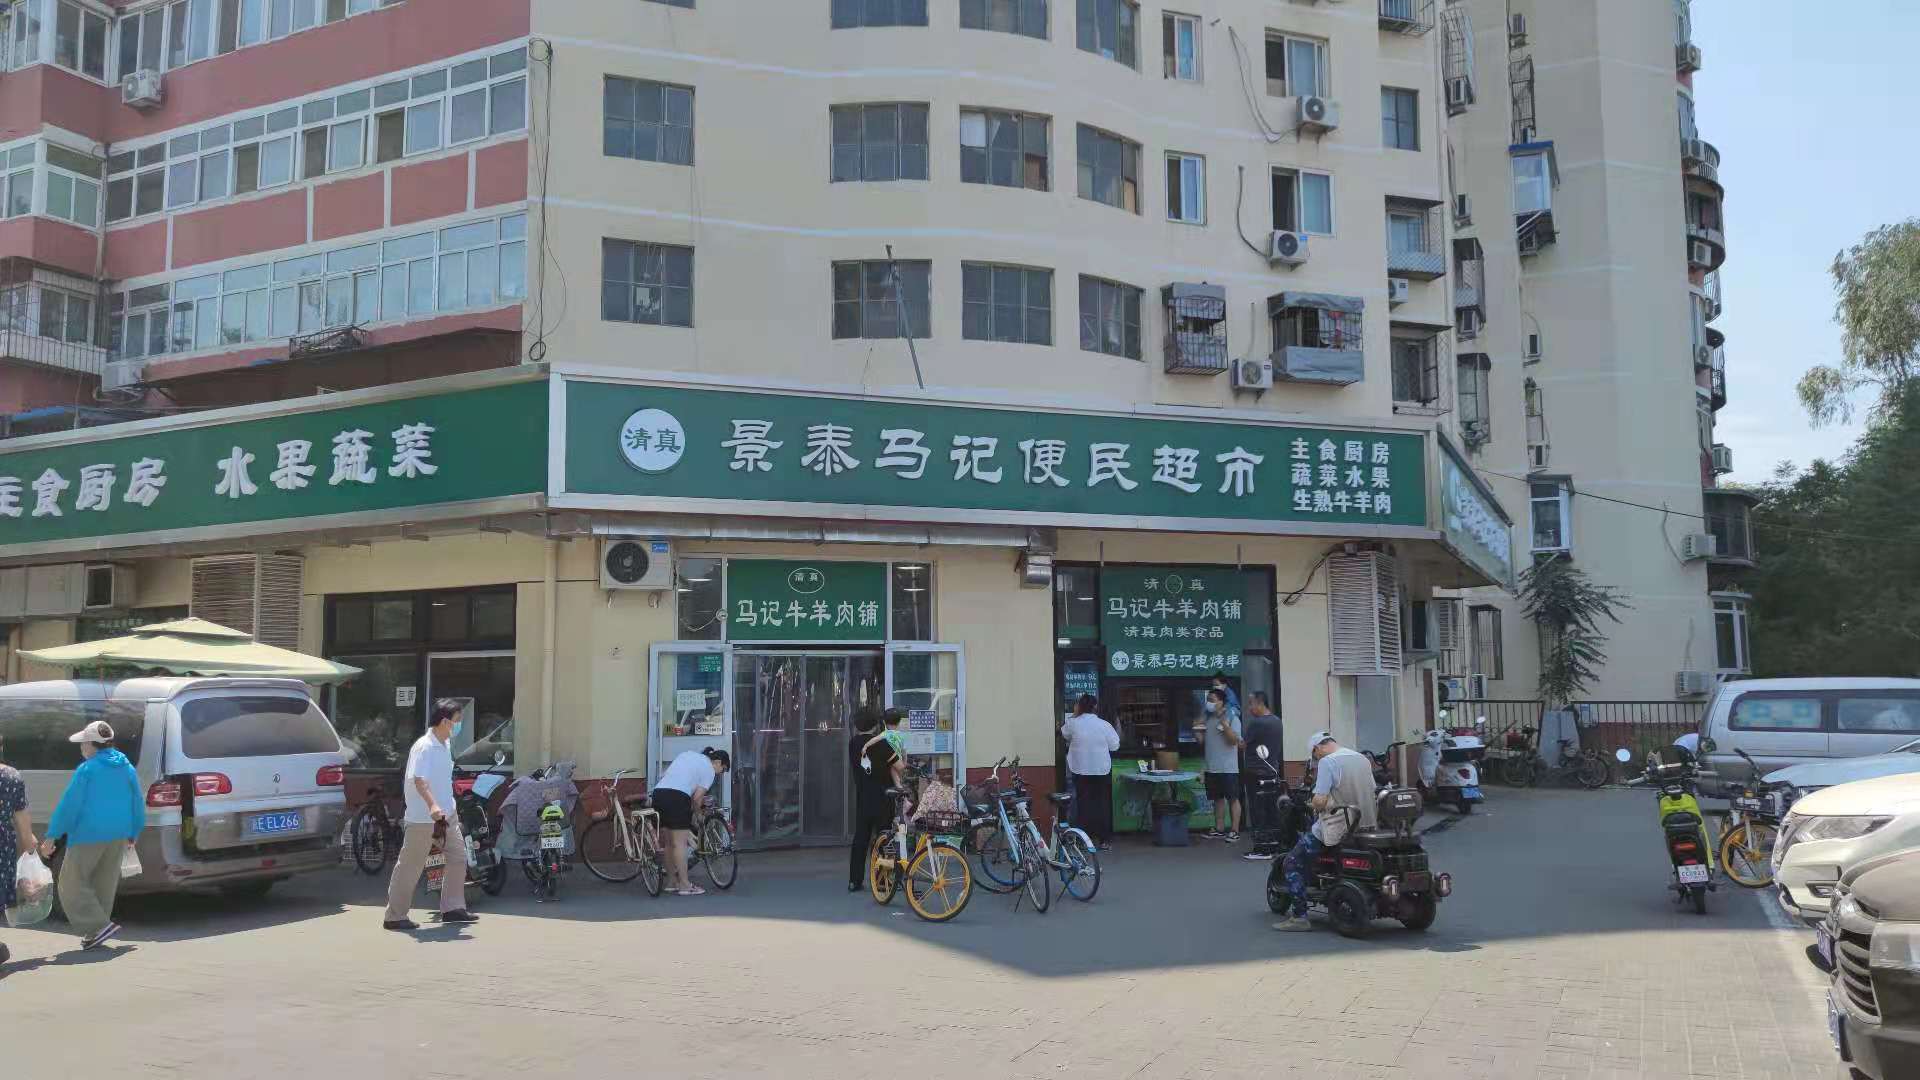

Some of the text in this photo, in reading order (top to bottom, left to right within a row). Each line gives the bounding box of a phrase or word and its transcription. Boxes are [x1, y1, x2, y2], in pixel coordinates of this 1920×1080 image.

[625, 427, 681, 453] 清真
[1290, 437, 1390, 465] 主食厨房
[215, 422, 439, 499] 水果蔬菜
[721, 418, 1265, 498] 景泰马记便民超市
[0, 456, 168, 517] 主食厨房
[1291, 463, 1390, 489] 蔬菜水果
[1292, 489, 1392, 514] 生熟牛羊肉
[735, 599, 879, 628] 马记牛羊肉铺
[1106, 597, 1243, 620] 马记牛羊肉铺
[1123, 625, 1224, 639] 清真肉类食品
[1131, 653, 1240, 669] 景泰马记电烤串
